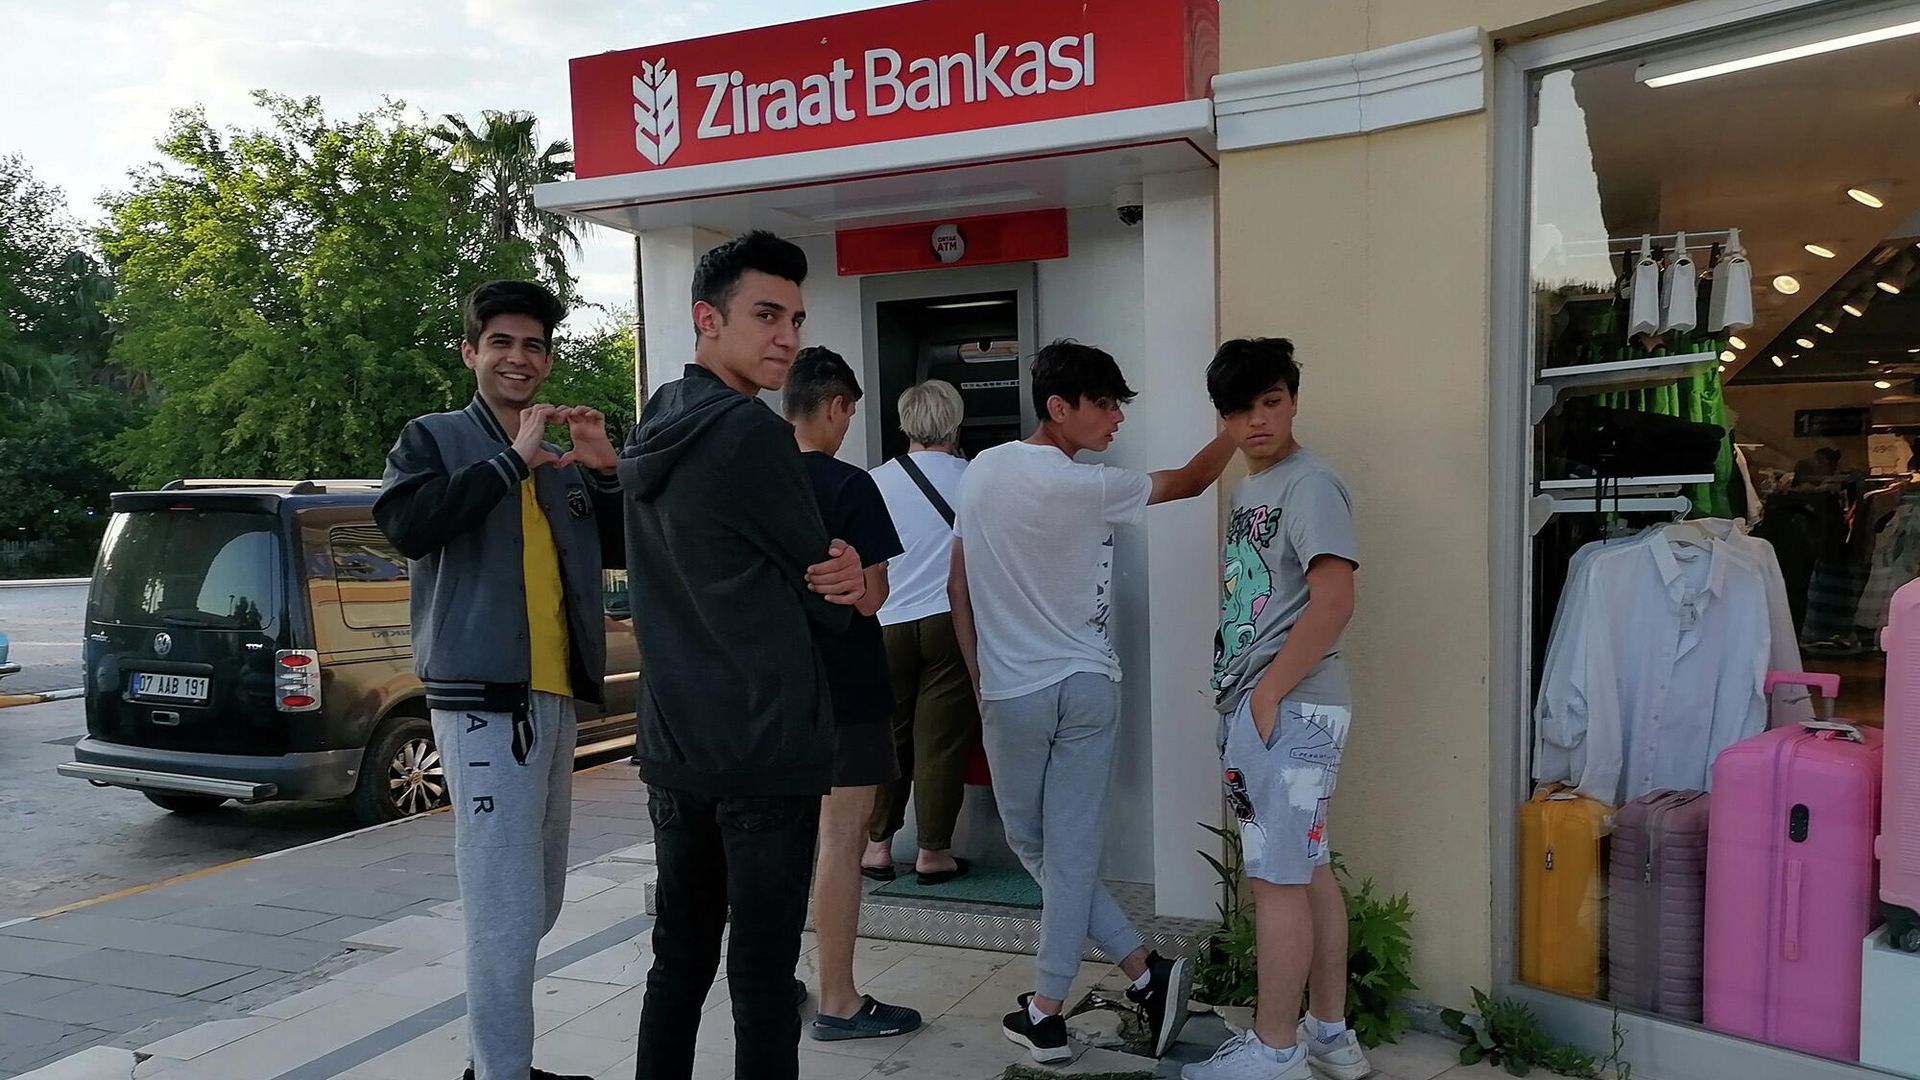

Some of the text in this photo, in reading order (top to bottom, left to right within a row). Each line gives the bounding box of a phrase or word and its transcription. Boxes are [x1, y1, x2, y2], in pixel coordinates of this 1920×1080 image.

[696, 32, 1095, 139] Ziraat Bankası
[937, 242, 957, 251] ATM
[140, 675, 205, 696] 07 AAB 191
[466, 713, 495, 815] AIR
